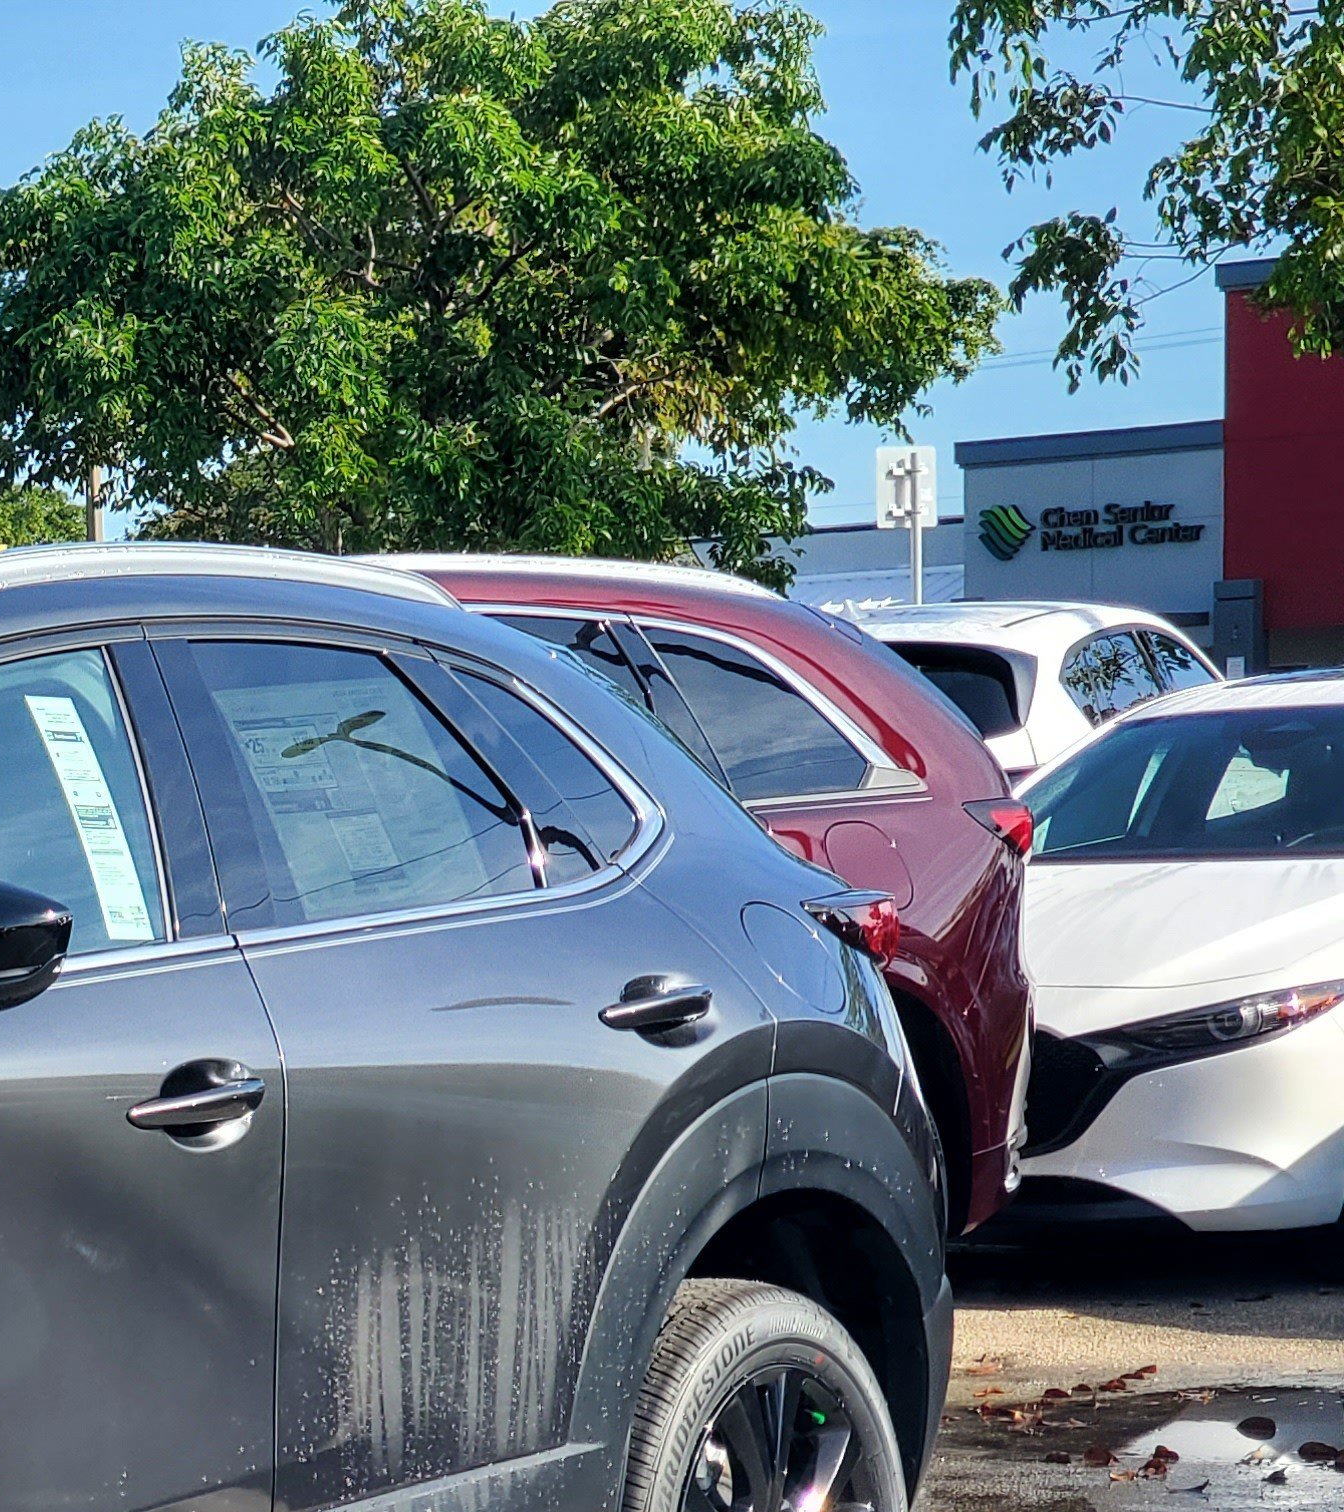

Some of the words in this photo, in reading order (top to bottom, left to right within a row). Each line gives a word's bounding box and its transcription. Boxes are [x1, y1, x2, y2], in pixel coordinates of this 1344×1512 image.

[1040, 507, 1099, 529] Chen
[1041, 525, 1123, 551] Medical
[1129, 522, 1205, 545] Center
